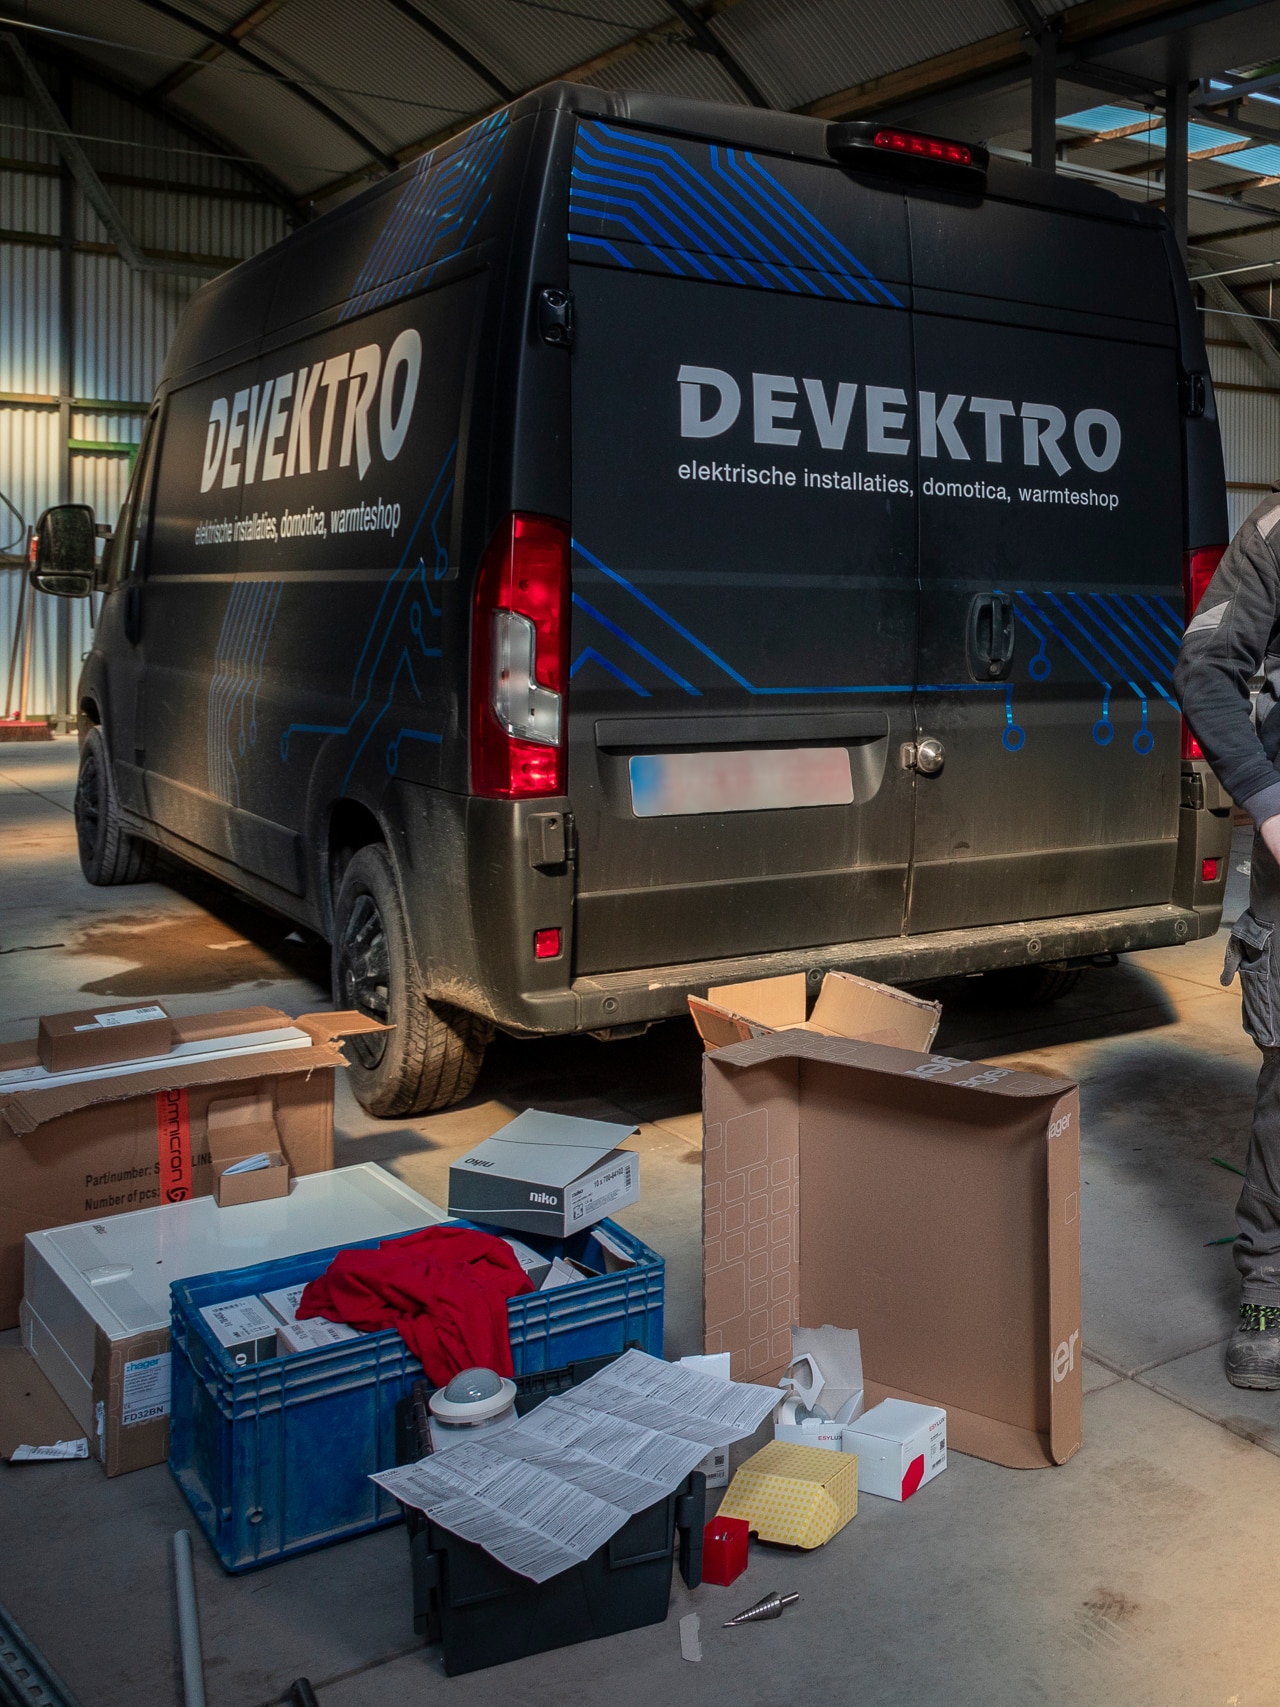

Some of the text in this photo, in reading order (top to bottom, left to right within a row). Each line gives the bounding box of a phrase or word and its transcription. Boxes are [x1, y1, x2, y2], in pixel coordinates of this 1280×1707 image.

[200, 328, 422, 494] DEVEKTRO
[676, 364, 1122, 477] DEVEKTRO
[678, 460, 1120, 510] elektrische installaties, domotica, warmteshop
[194, 518, 233, 546] elektrische
[280, 506, 327, 540] domotica,
[330, 497, 402, 538] warmteshop
[85, 1164, 152, 1188] Part/number:
[85, 1194, 125, 1211] Number
[127, 1191, 139, 1204] of
[529, 1191, 558, 1206] niko
[1050, 1328, 1079, 1393] er
[123, 1405, 164, 1423] FD32BN
[928, 1417, 946, 1432] ESYLUX
